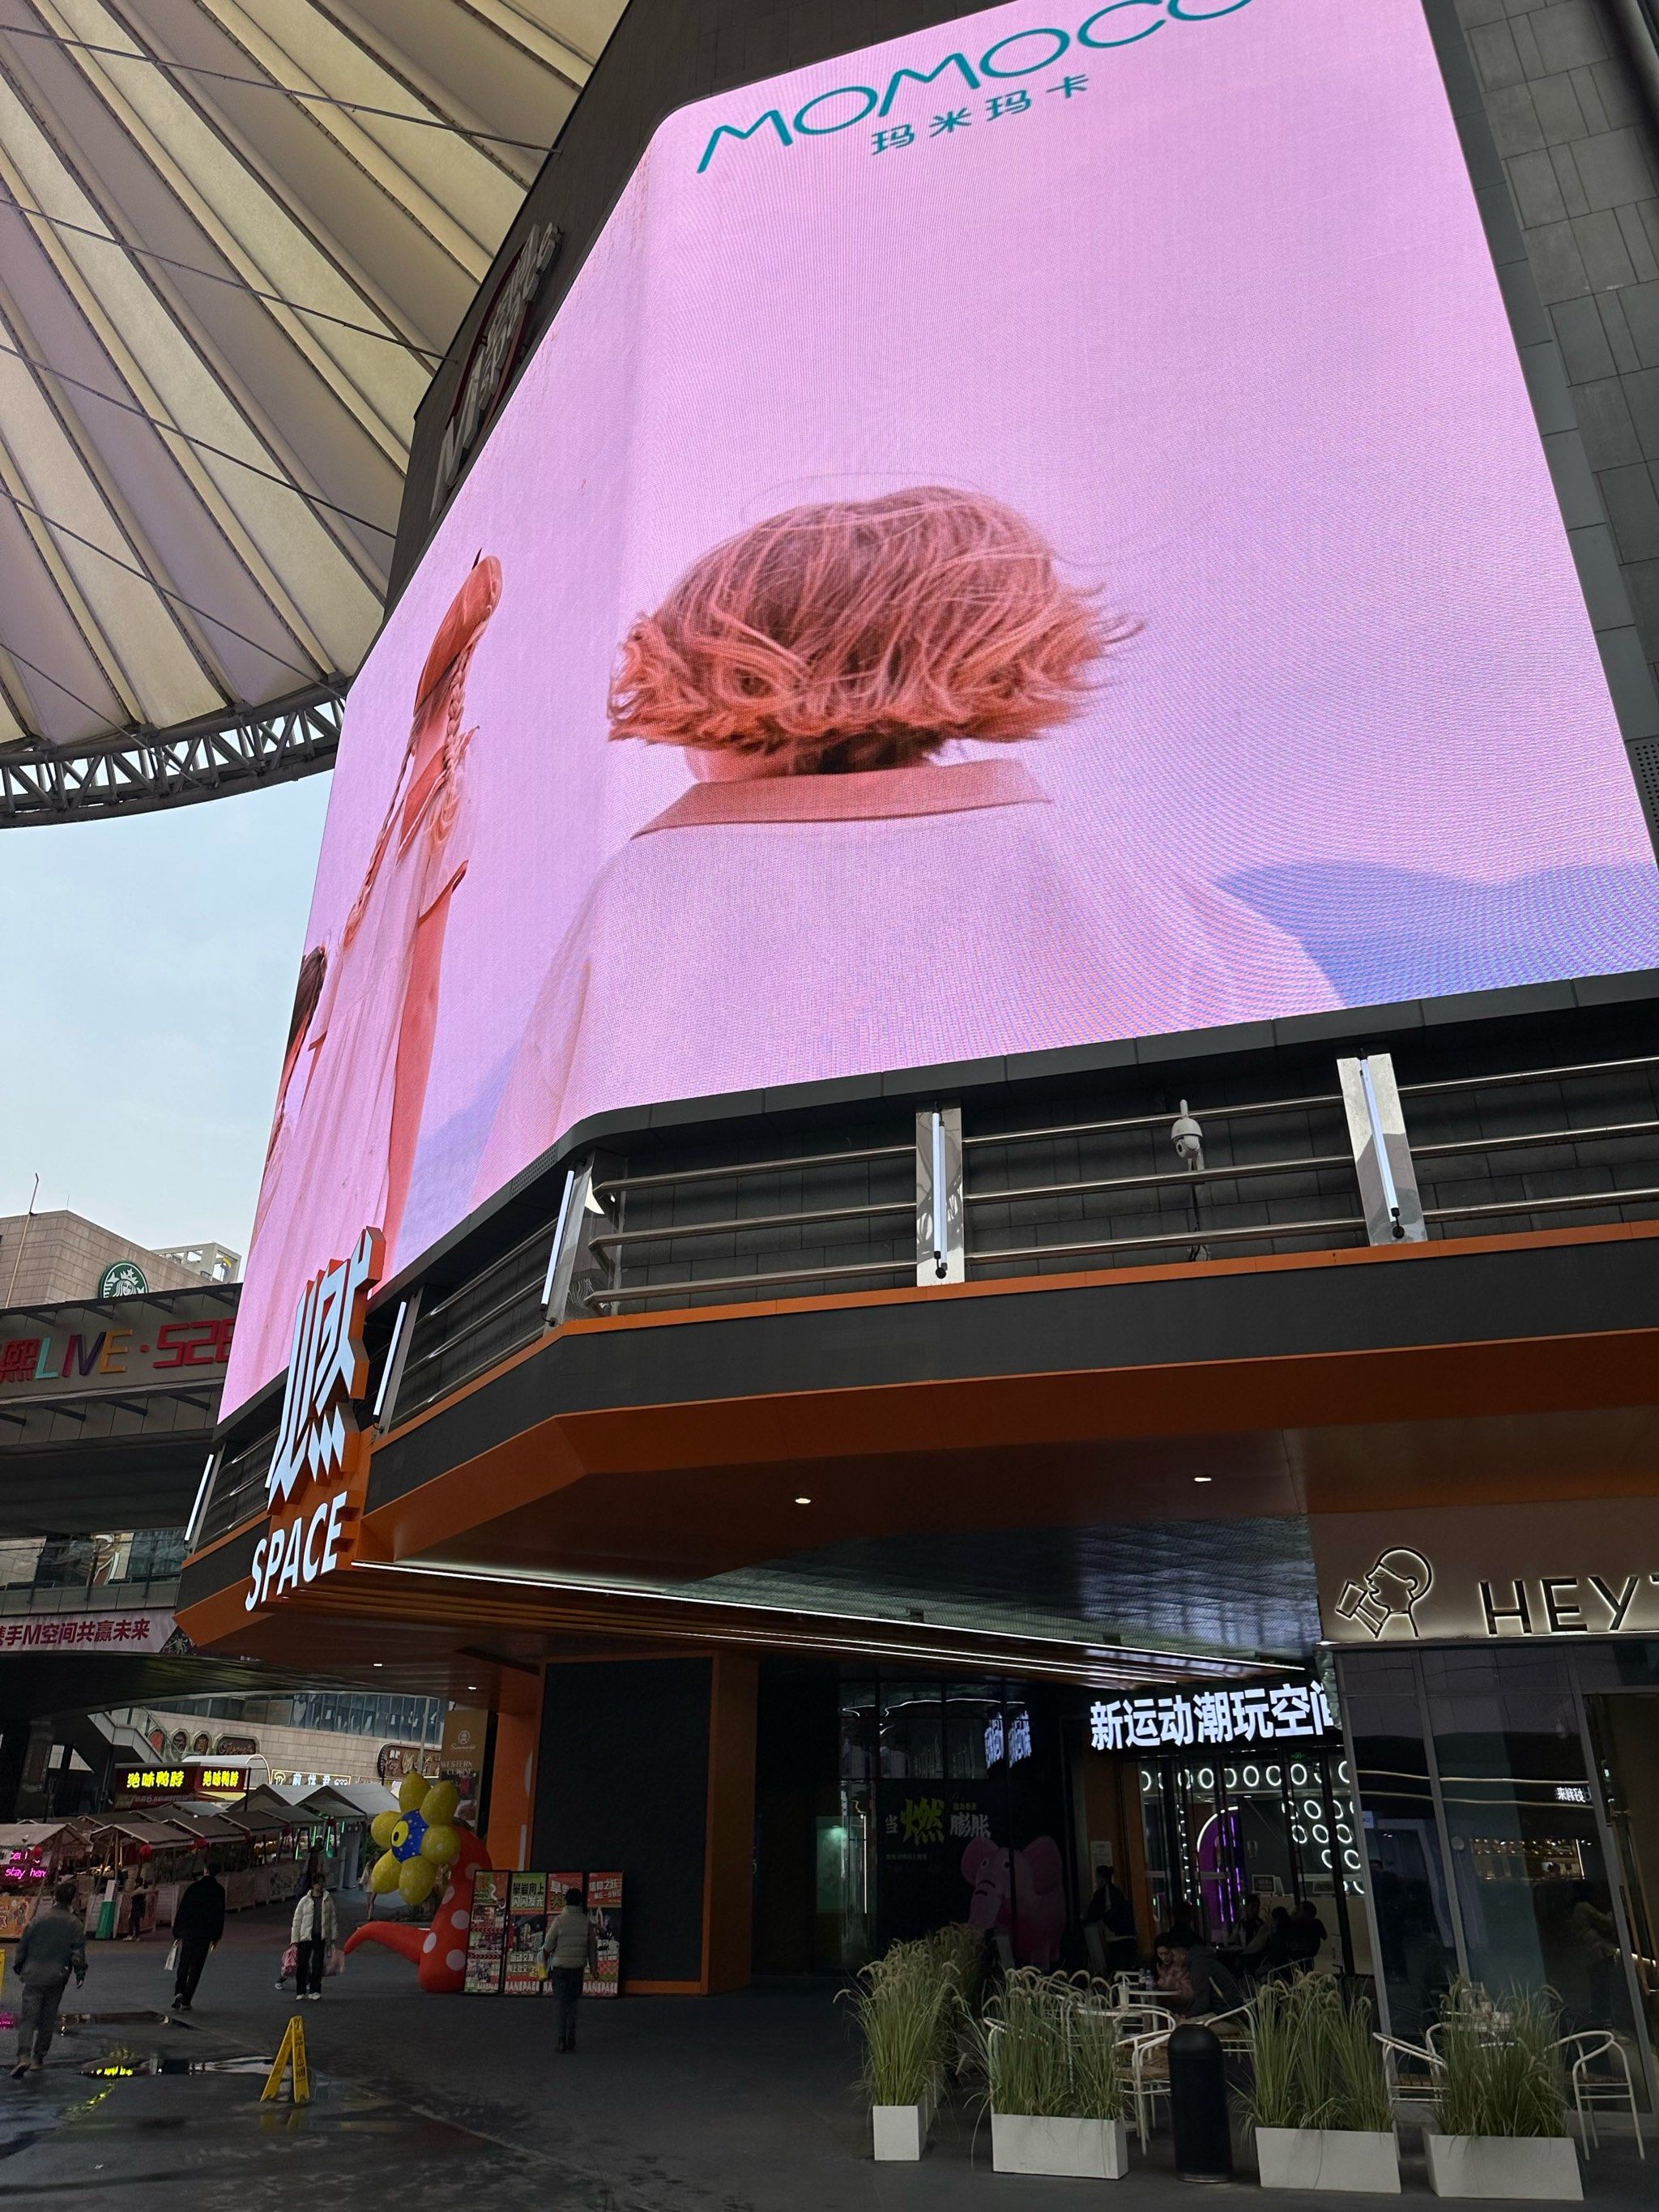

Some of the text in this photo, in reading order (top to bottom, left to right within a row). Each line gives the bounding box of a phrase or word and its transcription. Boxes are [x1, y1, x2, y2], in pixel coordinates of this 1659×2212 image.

[872, 74, 1090, 155] 玛米玛卡
[245, 1492, 347, 1611] SPACE
[1479, 1574, 1659, 1636] HEY
[126, 1770, 185, 1788] 绝味鸭脖
[203, 1770, 239, 1787] 绝味鸭脖
[5, 1866, 26, 1880] stay
[512, 1895, 544, 1907] 闪闪发光
